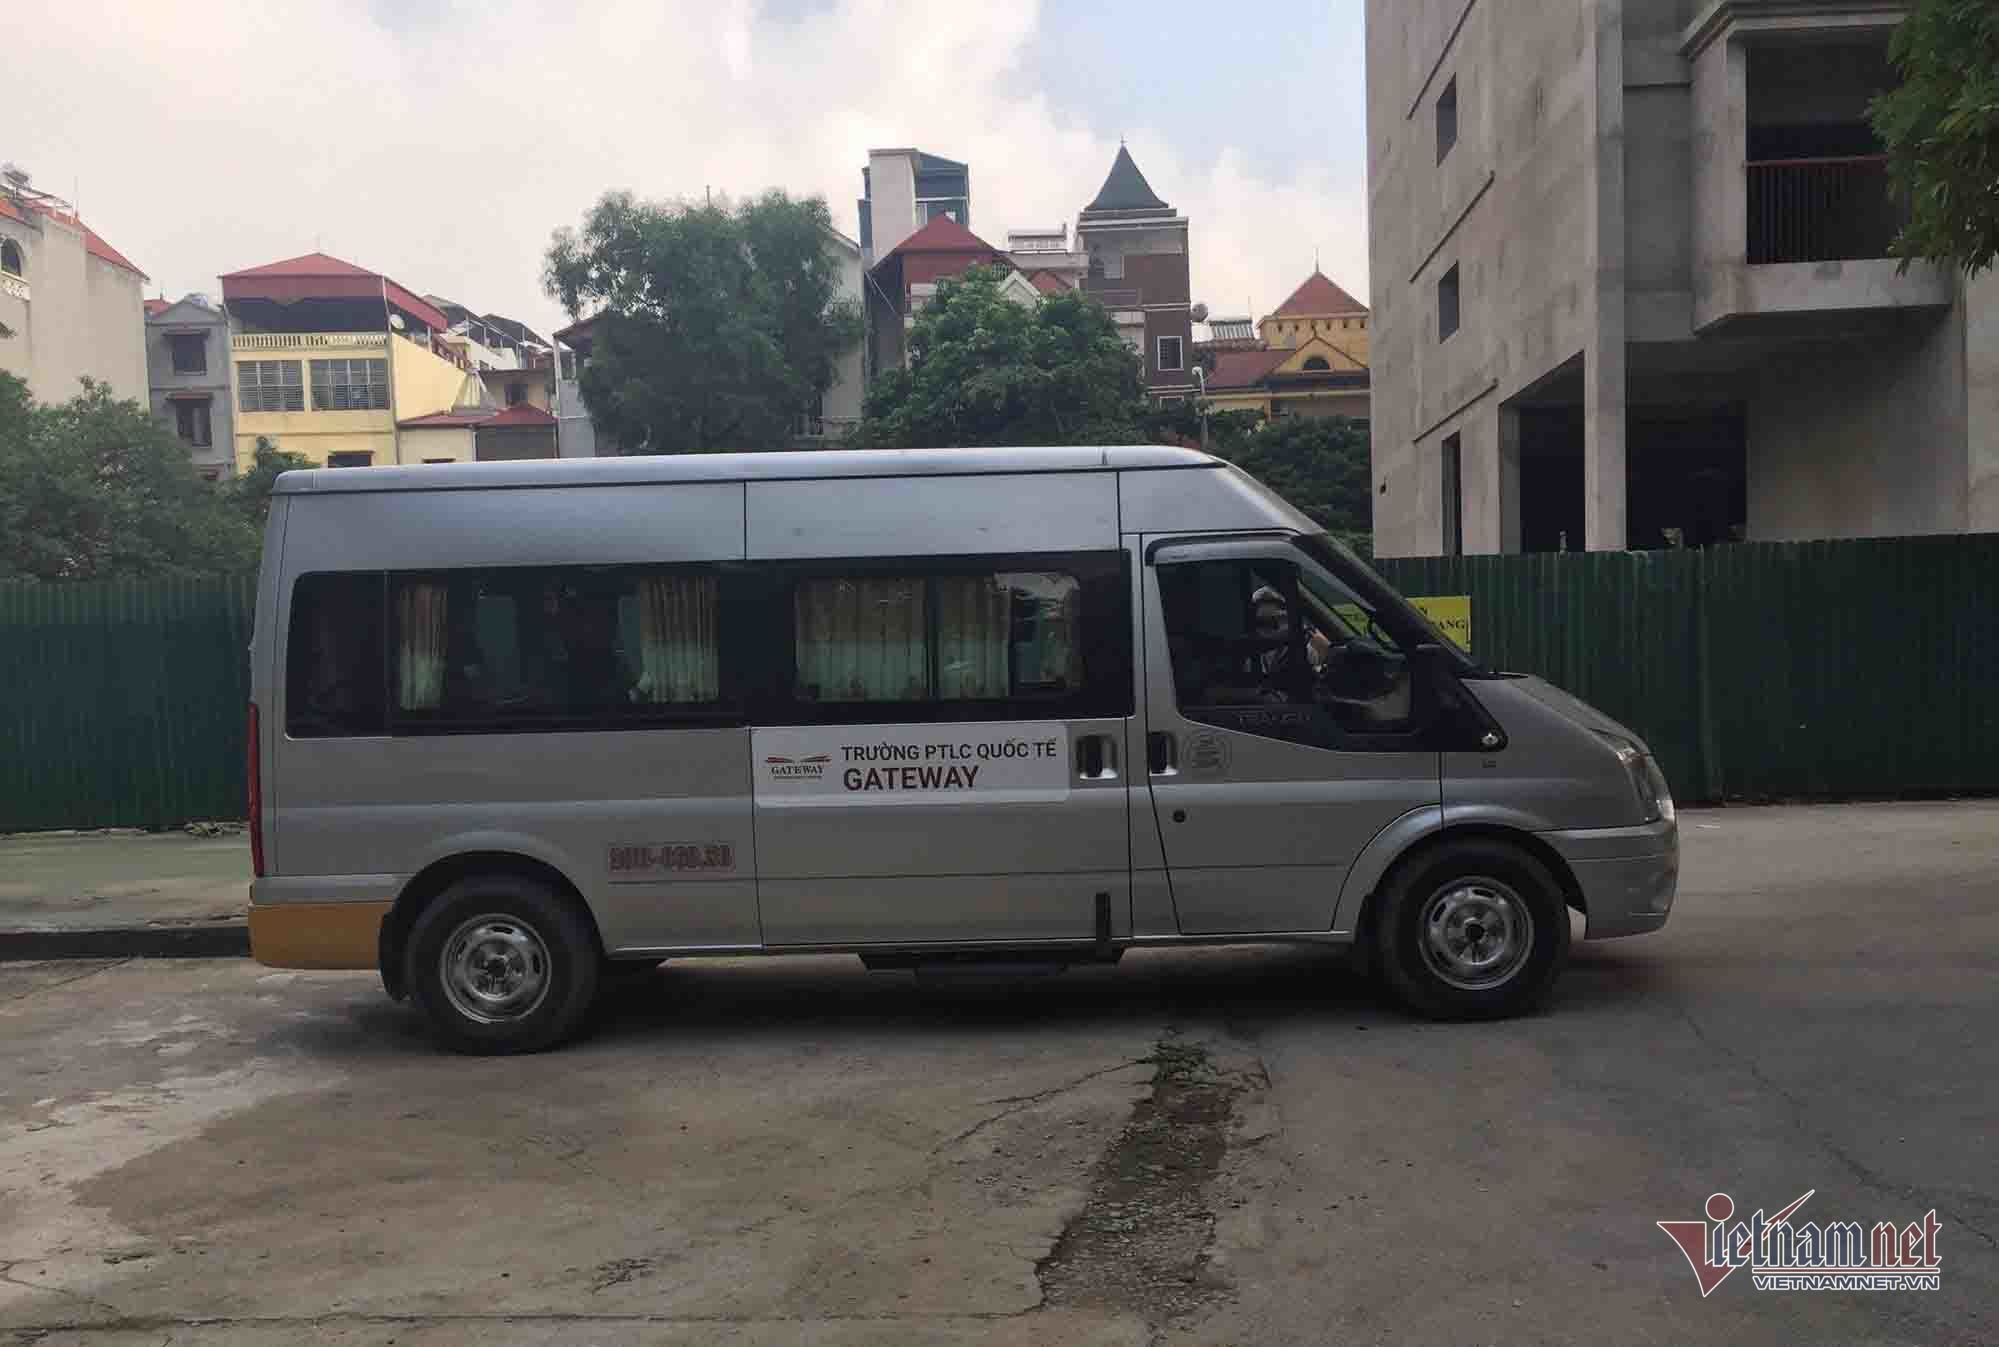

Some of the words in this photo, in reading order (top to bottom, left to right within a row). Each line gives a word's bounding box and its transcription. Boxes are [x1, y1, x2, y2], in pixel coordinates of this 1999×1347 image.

[841, 741, 919, 762] TRƯỜNG
[925, 743, 972, 760] PTLC
[977, 737, 1030, 760] QUỐC
[1032, 737, 1057, 758] TẾ
[771, 764, 824, 775] GATEWAY
[844, 765, 980, 791] GATEWAY
